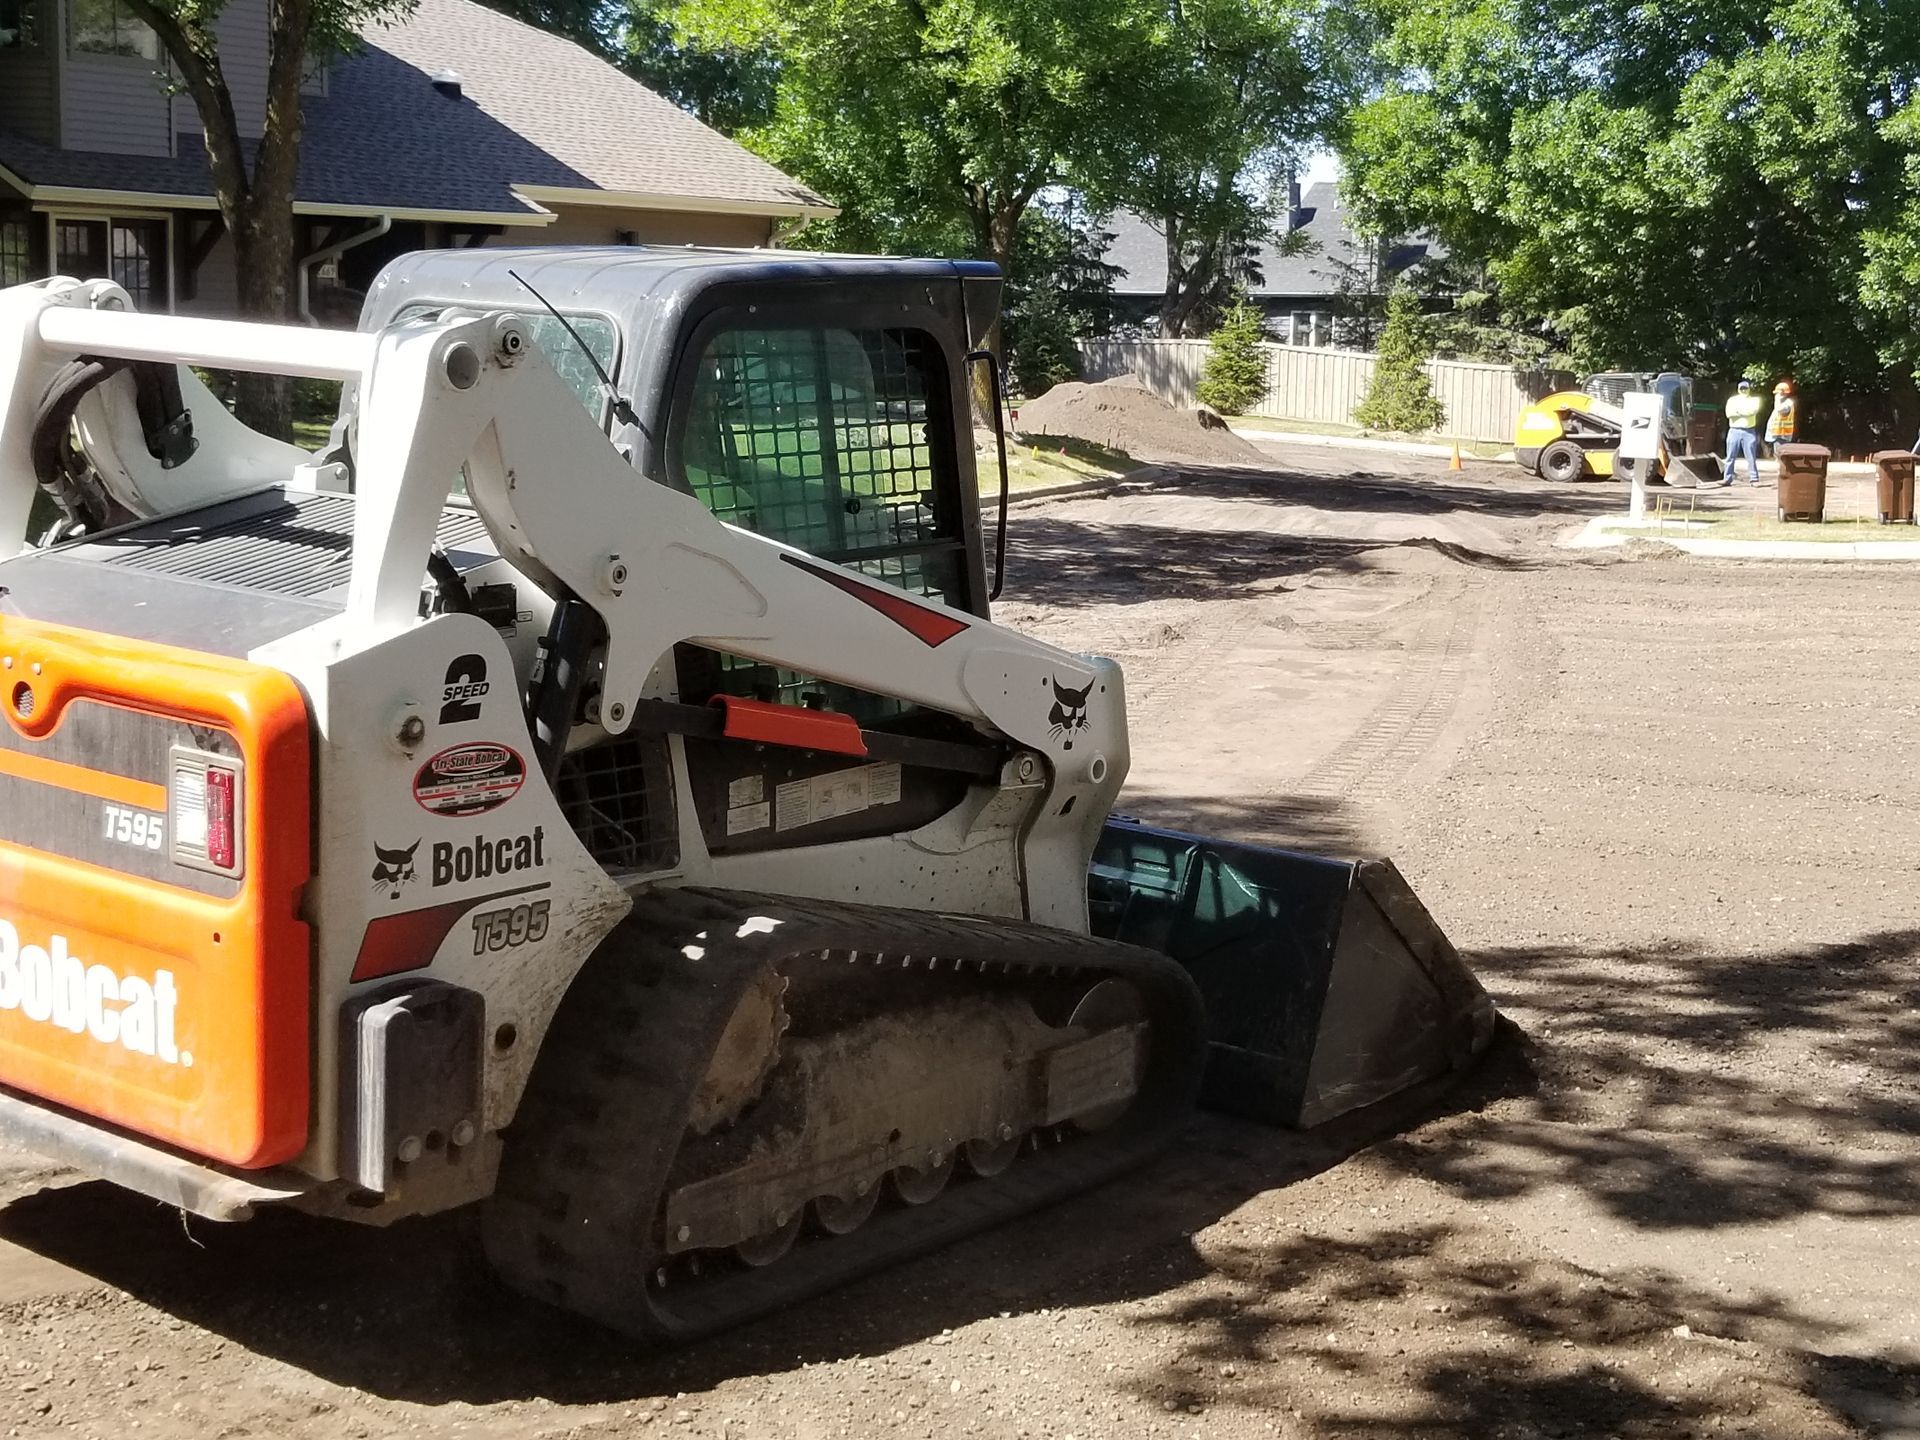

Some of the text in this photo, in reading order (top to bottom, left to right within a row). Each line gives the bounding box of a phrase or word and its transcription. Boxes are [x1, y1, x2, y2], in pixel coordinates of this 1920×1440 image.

[439, 654, 487, 725] 2
[442, 682, 490, 702] SPEED
[434, 750, 507, 770] Tri-State Bobcat
[104, 806, 164, 850] T595
[432, 826, 544, 887] Bobcat
[472, 899, 550, 956] T595
